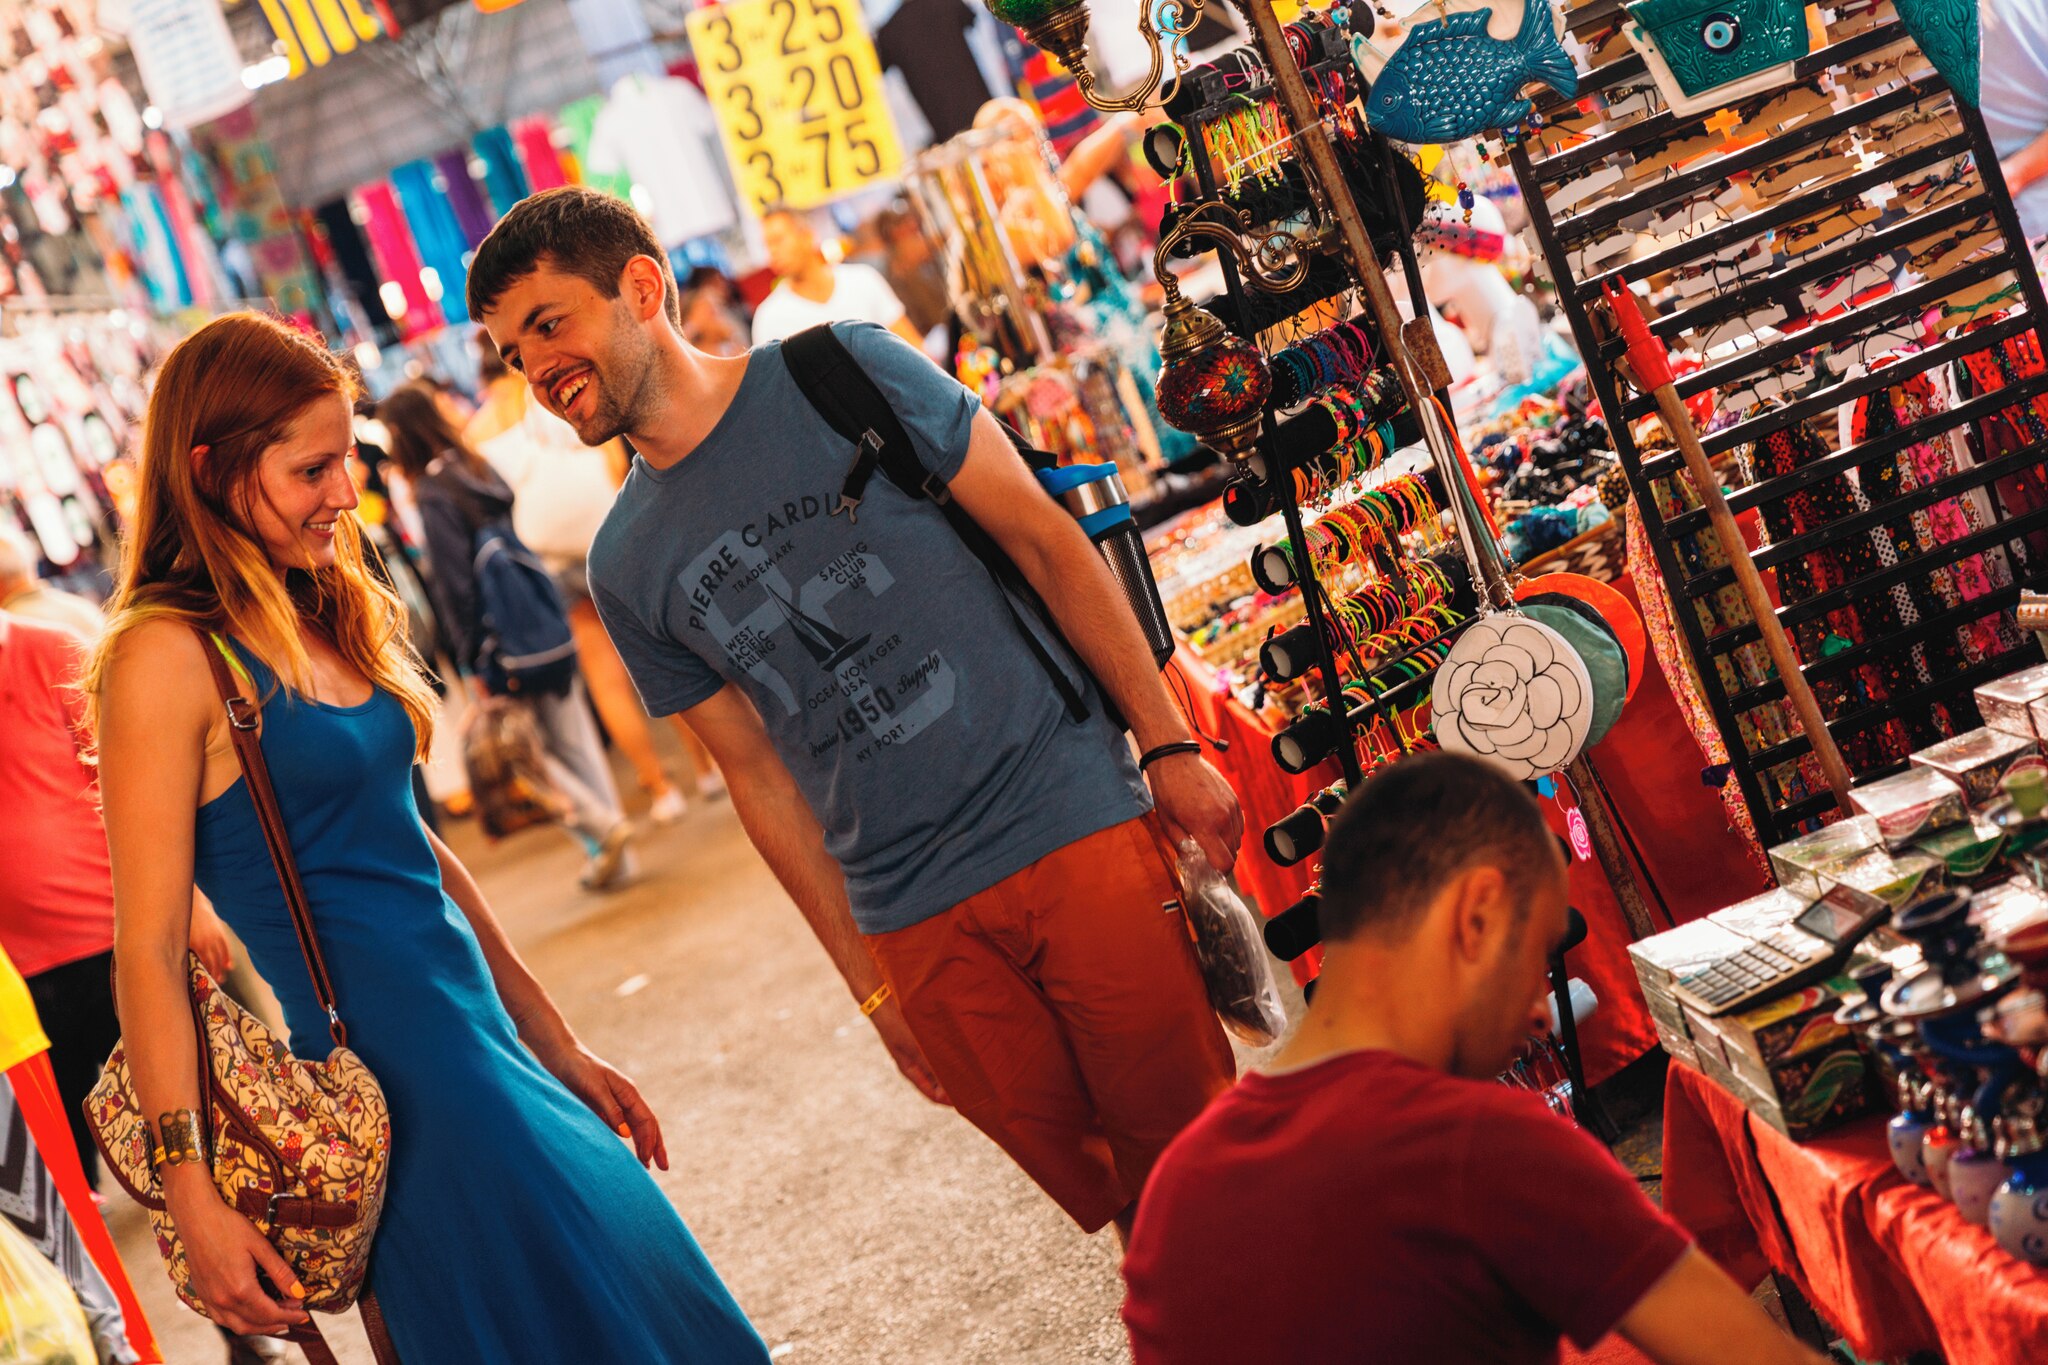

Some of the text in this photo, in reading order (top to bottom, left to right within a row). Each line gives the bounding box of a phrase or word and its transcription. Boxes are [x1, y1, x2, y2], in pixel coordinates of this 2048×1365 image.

[707, 15, 743, 73] 3
[727, 54, 863, 140] 3 20
[747, 119, 880, 207] 3 75
[732, 540, 795, 593] TRADEMARK
[819, 541, 867, 581] SAILING
[835, 558, 866, 584] CLUB
[849, 573, 866, 589] US
[689, 545, 738, 631] PIERRE
[725, 625, 753, 651] WEST
[727, 630, 769, 667] PACIFIC
[737, 640, 776, 673] SAILING
[840, 633, 903, 682] VOYAGER
[837, 686, 896, 742] 1950
[897, 653, 941, 694] Supply
[840, 676, 868, 698] USA
[856, 724, 906, 763] NY PORT
